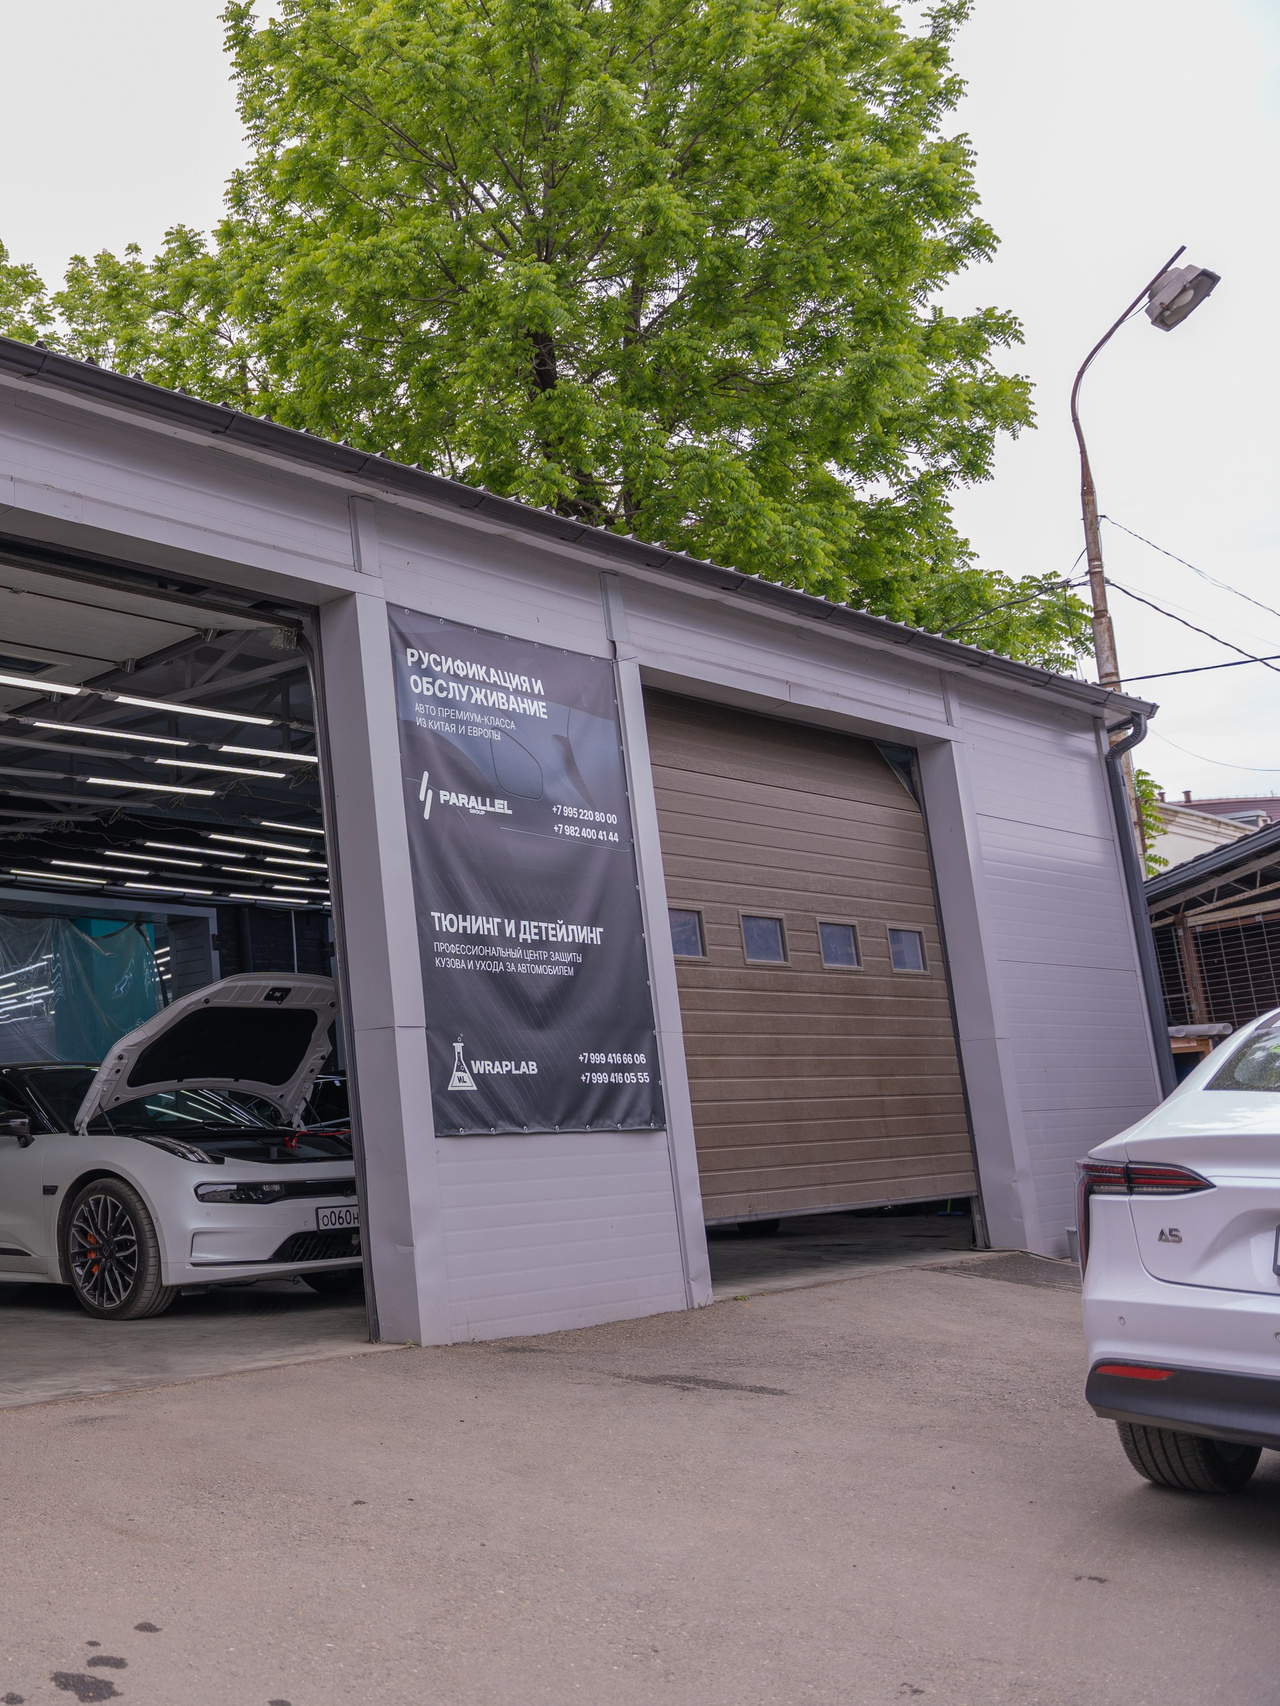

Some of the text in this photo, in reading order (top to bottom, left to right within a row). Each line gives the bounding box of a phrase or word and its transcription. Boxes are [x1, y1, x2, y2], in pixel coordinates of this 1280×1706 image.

[406, 647, 545, 695] РУСИФИКАЦИЯ И
[410, 674, 548, 719] ОБСЛУЖИВАНИЕ
[414, 702, 516, 731] АВТО ПРЕМИУМ-КЛАССА
[416, 716, 501, 741] ИЗ КИТАЯ И ЕВРОПЫ
[439, 790, 513, 815] PARALLEL
[469, 808, 486, 816] GROUP
[552, 805, 618, 825] +7 995 220 80 00
[553, 824, 619, 842] +7 982 400 41 44
[430, 911, 604, 945] ТЮНИНГ И ДЕТЕЙЛИНГ
[434, 942, 582, 963] ПРОФЕССИОНАЛЬНЫЙ ЦЕНТР ЗАЩИТЫ
[435, 957, 574, 976] КУЗОВА И УХОДА ЗА АВТОМОБИЛЕМ
[471, 1060, 538, 1075] WRAPLAB
[578, 1053, 646, 1064] +7 999 416 66 06
[580, 1072, 650, 1083] +7 999 416 05 55
[1157, 1227, 1183, 1244] A5
